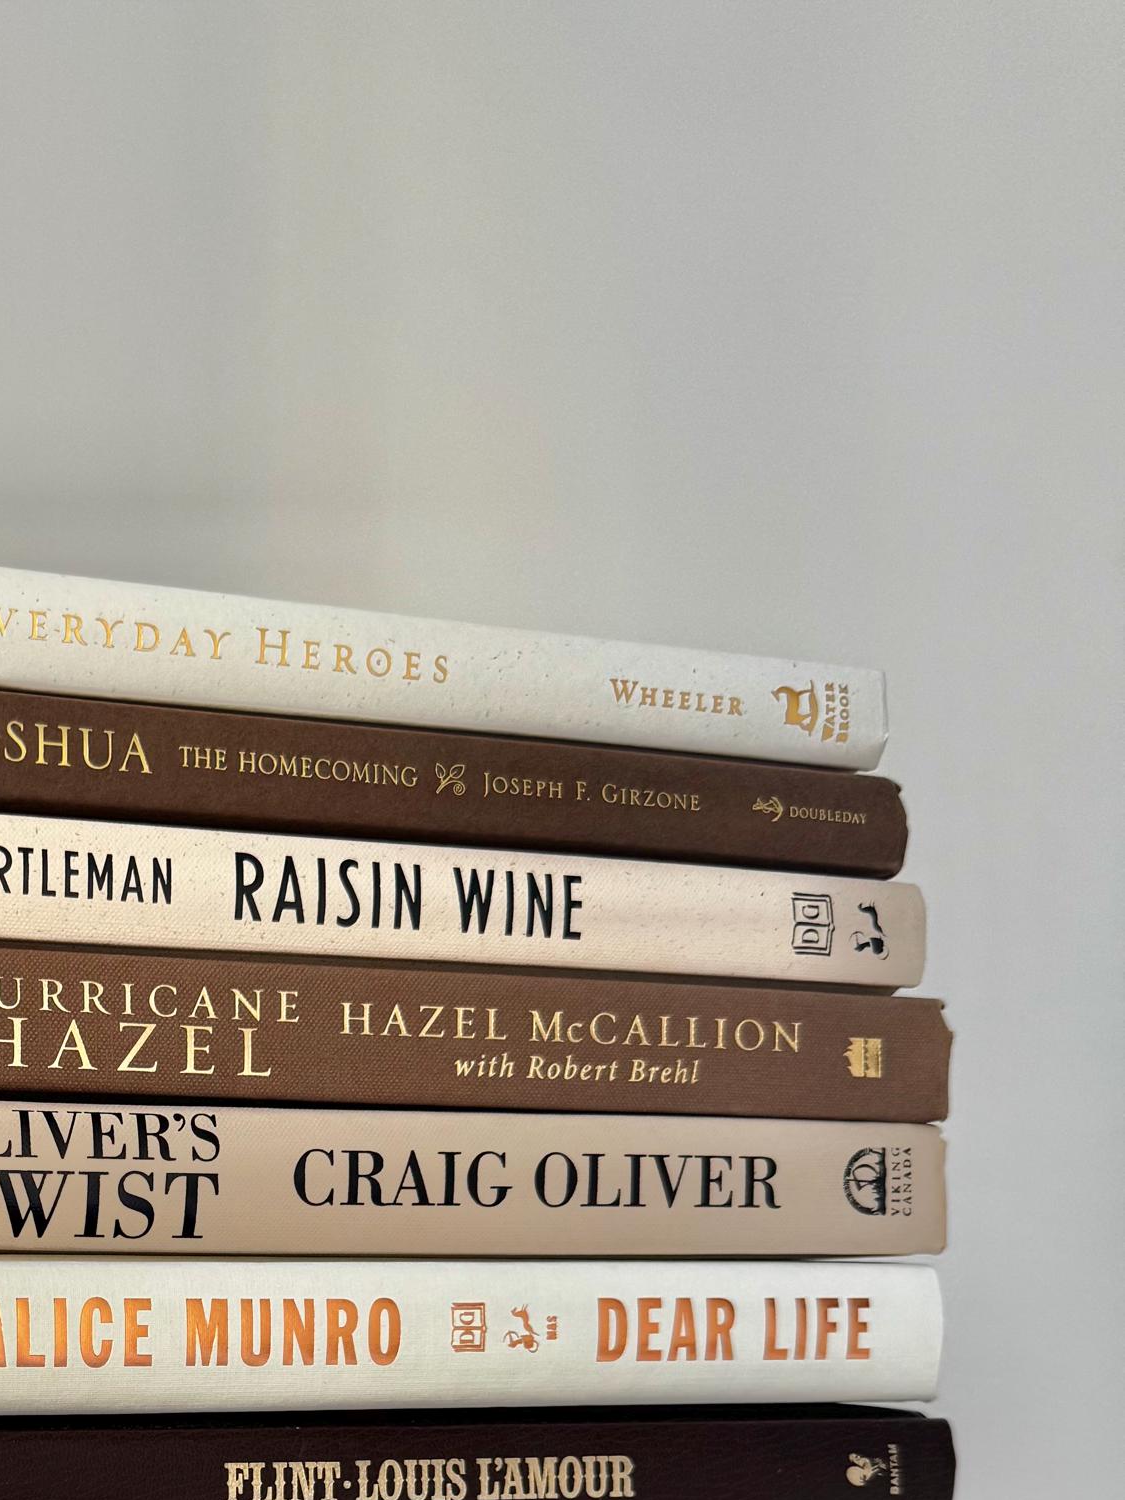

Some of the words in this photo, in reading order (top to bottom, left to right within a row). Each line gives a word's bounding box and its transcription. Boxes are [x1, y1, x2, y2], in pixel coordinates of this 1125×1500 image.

[255, 627, 450, 684] HEROES
[610, 678, 744, 717] WHEELER
[820, 681, 835, 743] WATER
[836, 683, 850, 744] BROOK
[179, 745, 228, 772] THE
[239, 751, 418, 789] HOMECOMING
[483, 771, 564, 800] JOSEPH
[575, 782, 590, 802] F.
[602, 784, 700, 812] GIRZONE
[789, 806, 867, 825] DOUBLEDAY
[233, 851, 422, 931] RAISIN
[453, 867, 583, 940] WINE
[340, 1003, 507, 1041] HAZEL
[529, 1009, 803, 1053] McCALLION
[454, 1055, 515, 1080] with
[527, 1057, 618, 1082] Robert
[628, 1059, 700, 1085] Brehl
[293, 1149, 513, 1208] CRAIG
[533, 1151, 782, 1210] OLIVER
[891, 1147, 901, 1217] VIKING
[902, 1147, 912, 1217] CANADA
[185, 1297, 402, 1367] MUNRO
[596, 1296, 736, 1363] DEAR
[762, 1297, 871, 1362] LIFE
[476, 1455, 636, 1500] L'AMOUR
[889, 1443, 900, 1496] BANTAM
